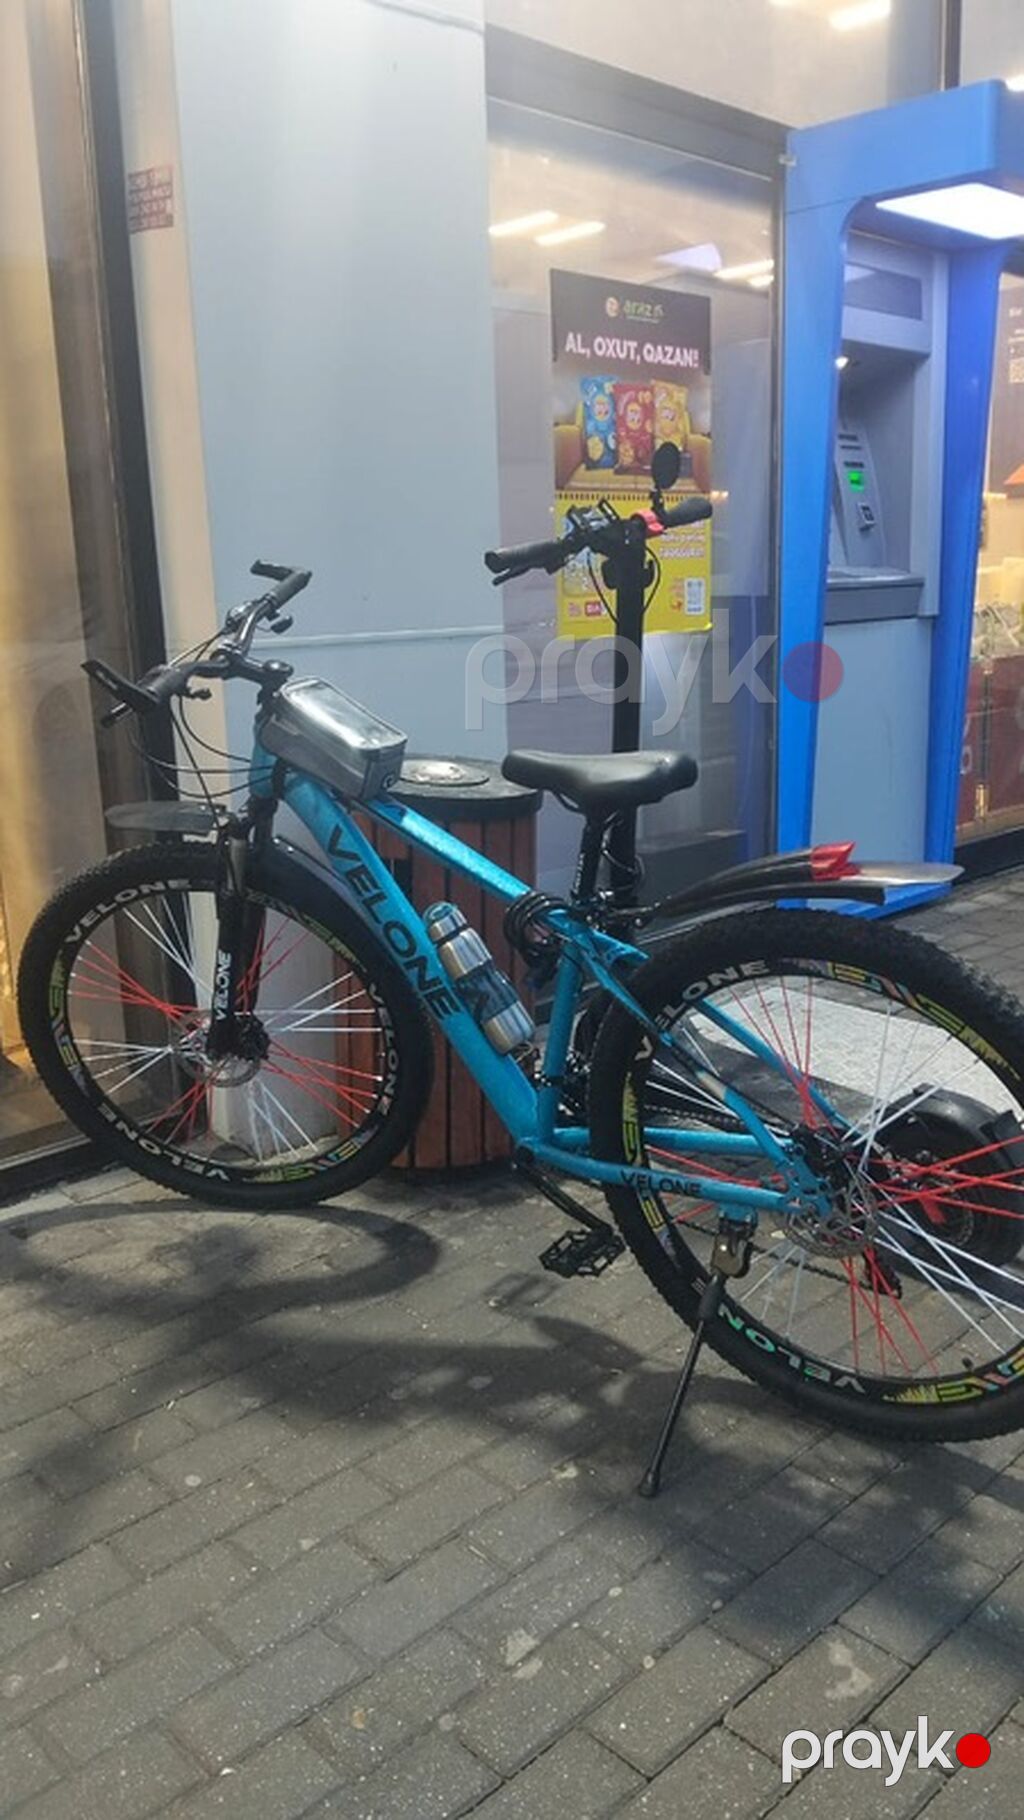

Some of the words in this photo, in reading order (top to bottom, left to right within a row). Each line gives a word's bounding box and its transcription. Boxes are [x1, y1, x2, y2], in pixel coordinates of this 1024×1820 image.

[565, 331, 591, 358] AL,
[593, 337, 641, 364] OXUT,
[643, 344, 699, 368] QAZAN!
[64, 878, 190, 944] VELONE
[328, 824, 461, 1020] VELONE
[215, 948, 231, 1021] VELONE
[368, 983, 399, 1116] VELONE
[98, 1103, 229, 1183] VELONE
[620, 1170, 701, 1195] VELONE
